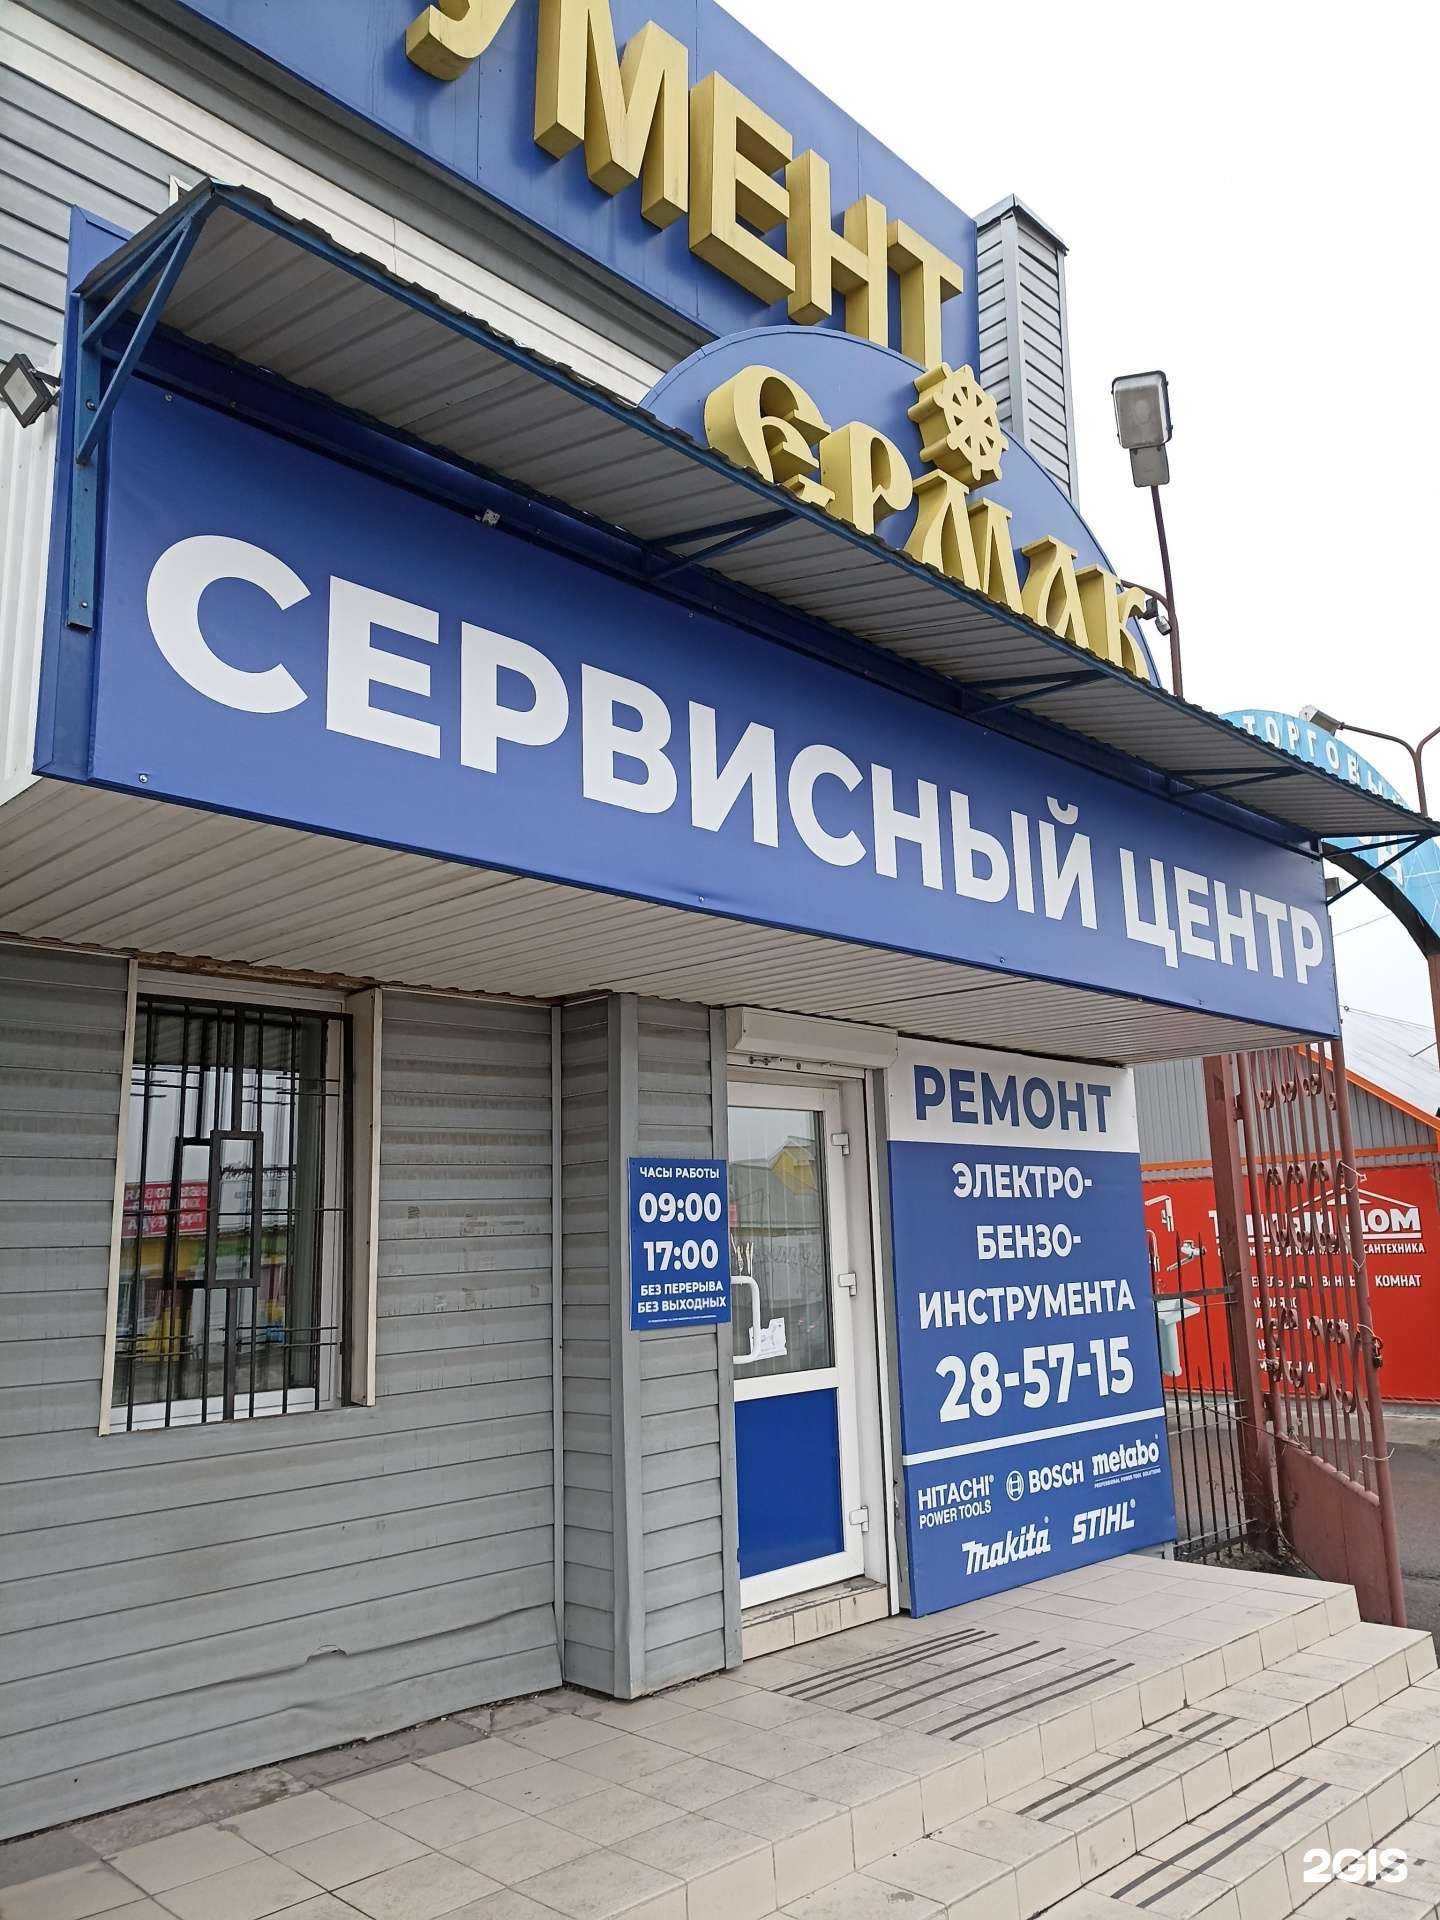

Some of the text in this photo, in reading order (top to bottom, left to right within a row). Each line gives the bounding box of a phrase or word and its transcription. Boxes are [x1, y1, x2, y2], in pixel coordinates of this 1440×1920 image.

[146, 535, 1324, 985] СЕРВИСНЫЙ ЦЕНТР
[1242, 715, 1406, 806] ТОРГОВЫ
[913, 1063, 1112, 1133] РЕМОНТ
[639, 1166, 720, 1179] ЧАСЫ РАБОТЫ
[951, 1162, 1093, 1200] ЭЛЕКТРО-
[638, 1192, 722, 1223] 09:00
[643, 1238, 719, 1272] 17:00
[976, 1223, 1081, 1260] БЕНЗО-
[640, 1280, 724, 1297] БЕЗ ПЕРЕРЫВА
[1375, 1275, 1422, 1287] КОМНАТ
[637, 1296, 727, 1314] БЕЗ ВЫХОДНЫХ
[918, 1279, 1136, 1330] ИНСТРУМЕНТА
[935, 1336, 1134, 1423] 28-57-15
[1092, 1439, 1160, 1476] metabo
[1028, 1460, 1084, 1494] BOSCH
[919, 1499, 992, 1529] POWER TOOLS
